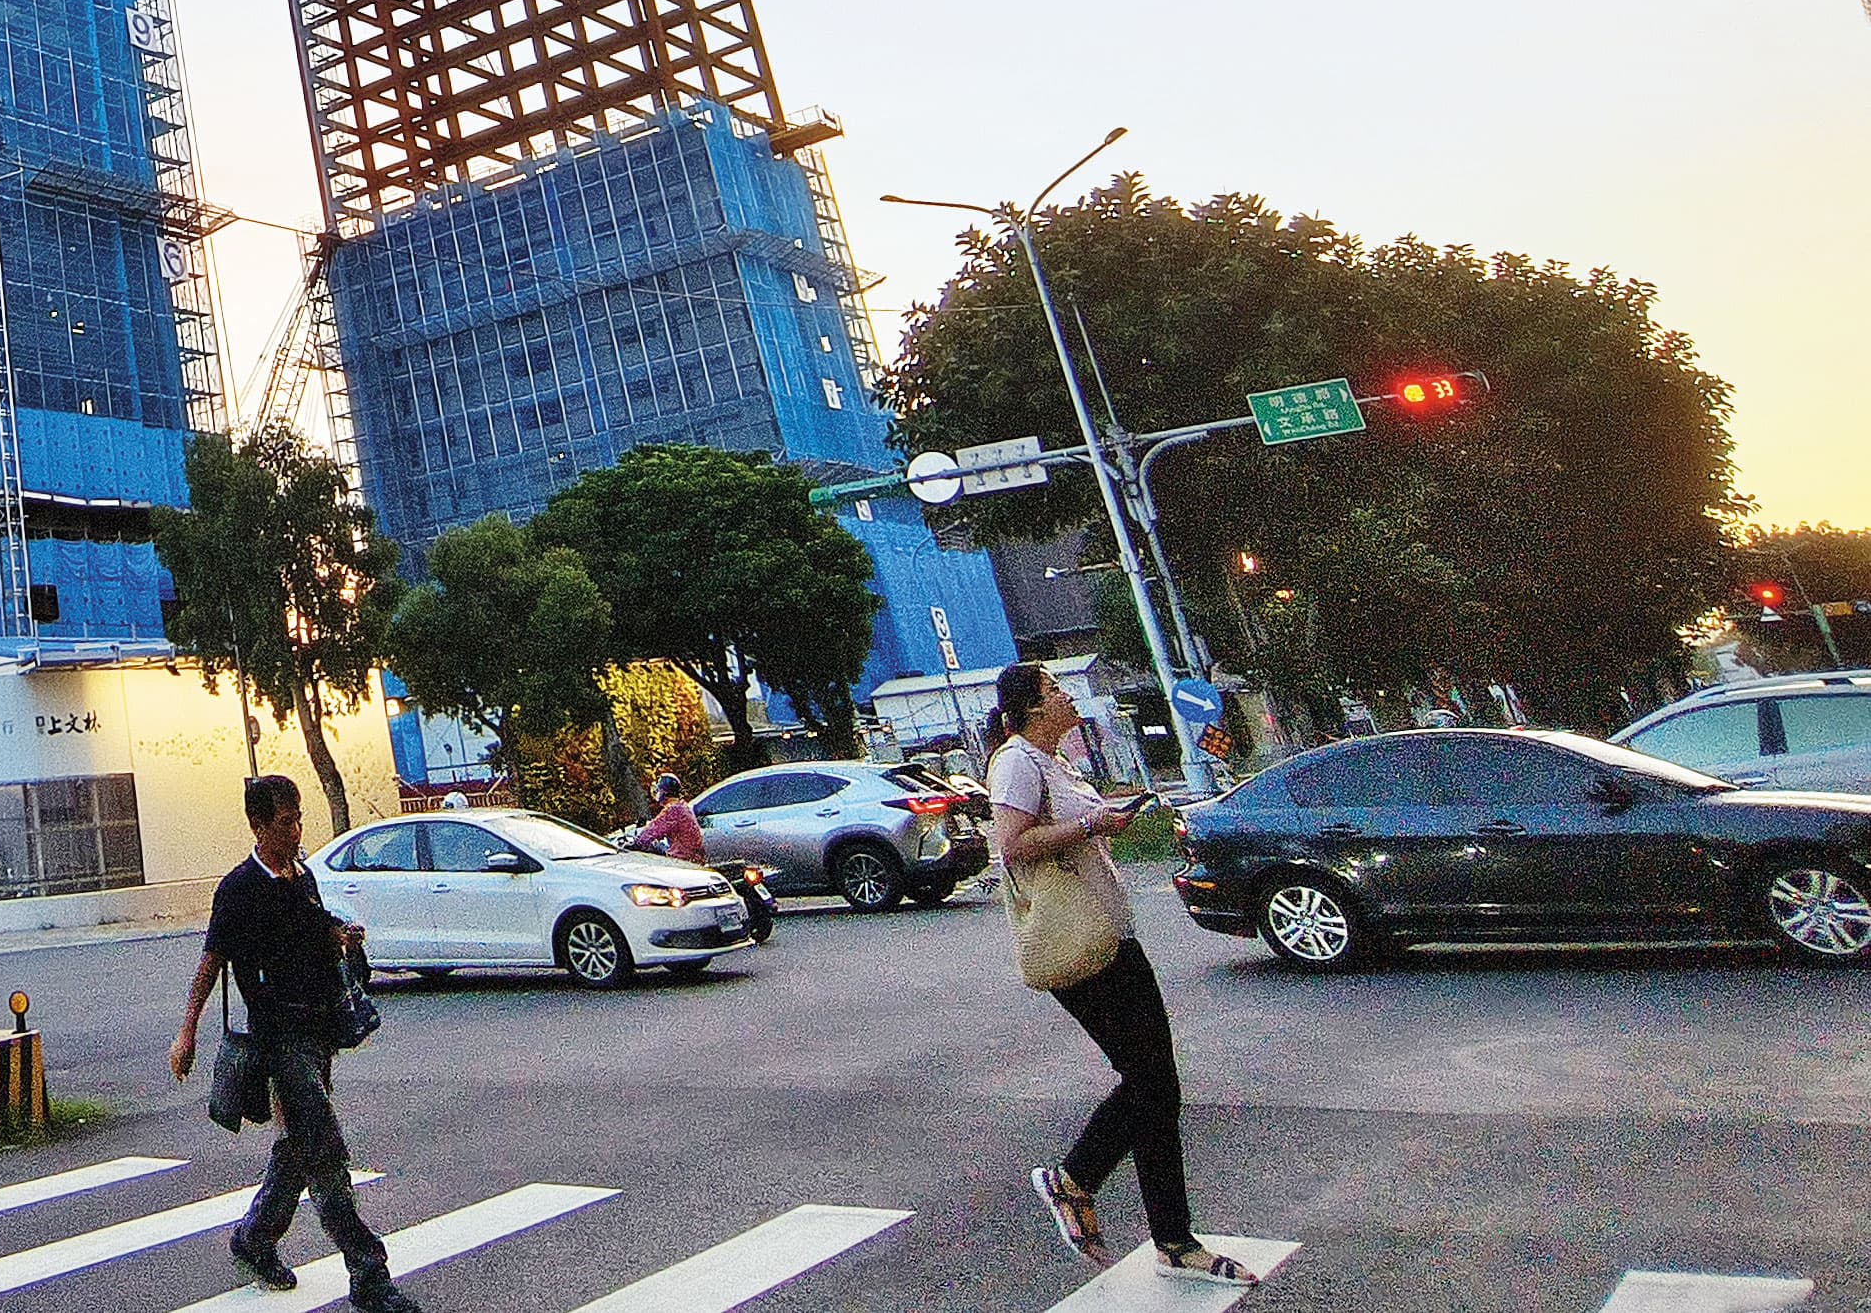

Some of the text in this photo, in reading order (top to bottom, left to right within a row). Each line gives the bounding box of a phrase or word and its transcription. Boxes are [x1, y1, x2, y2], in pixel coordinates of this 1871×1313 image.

[132, 14, 151, 47] 9
[163, 242, 185, 277] 6
[1432, 380, 1454, 398] 33
[47, 710, 101, 735] 上文林
